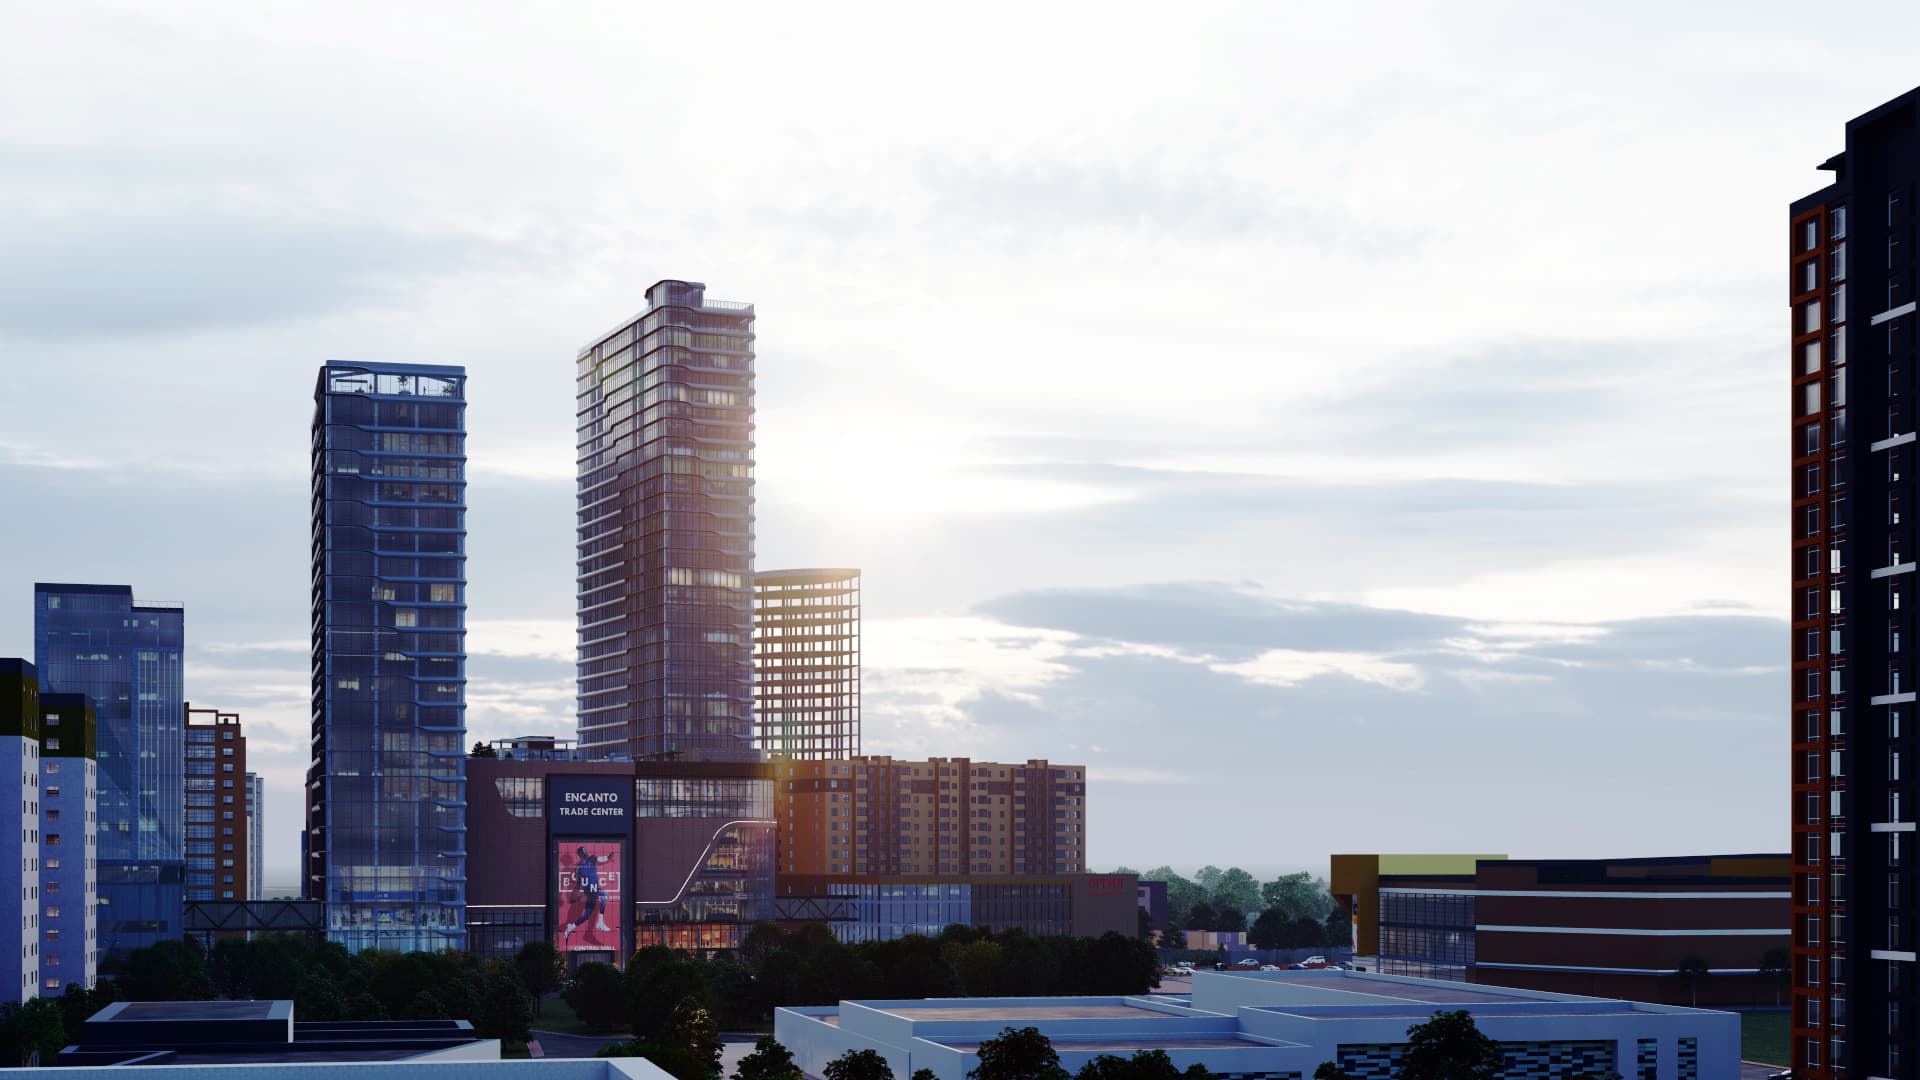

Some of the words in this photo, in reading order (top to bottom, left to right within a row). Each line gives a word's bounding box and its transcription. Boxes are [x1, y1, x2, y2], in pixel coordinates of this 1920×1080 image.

[565, 792, 618, 802] ENCANTO
[560, 807, 589, 816] TRADE
[591, 807, 624, 816] CENTER
[563, 872, 615, 893] BOUNCE
